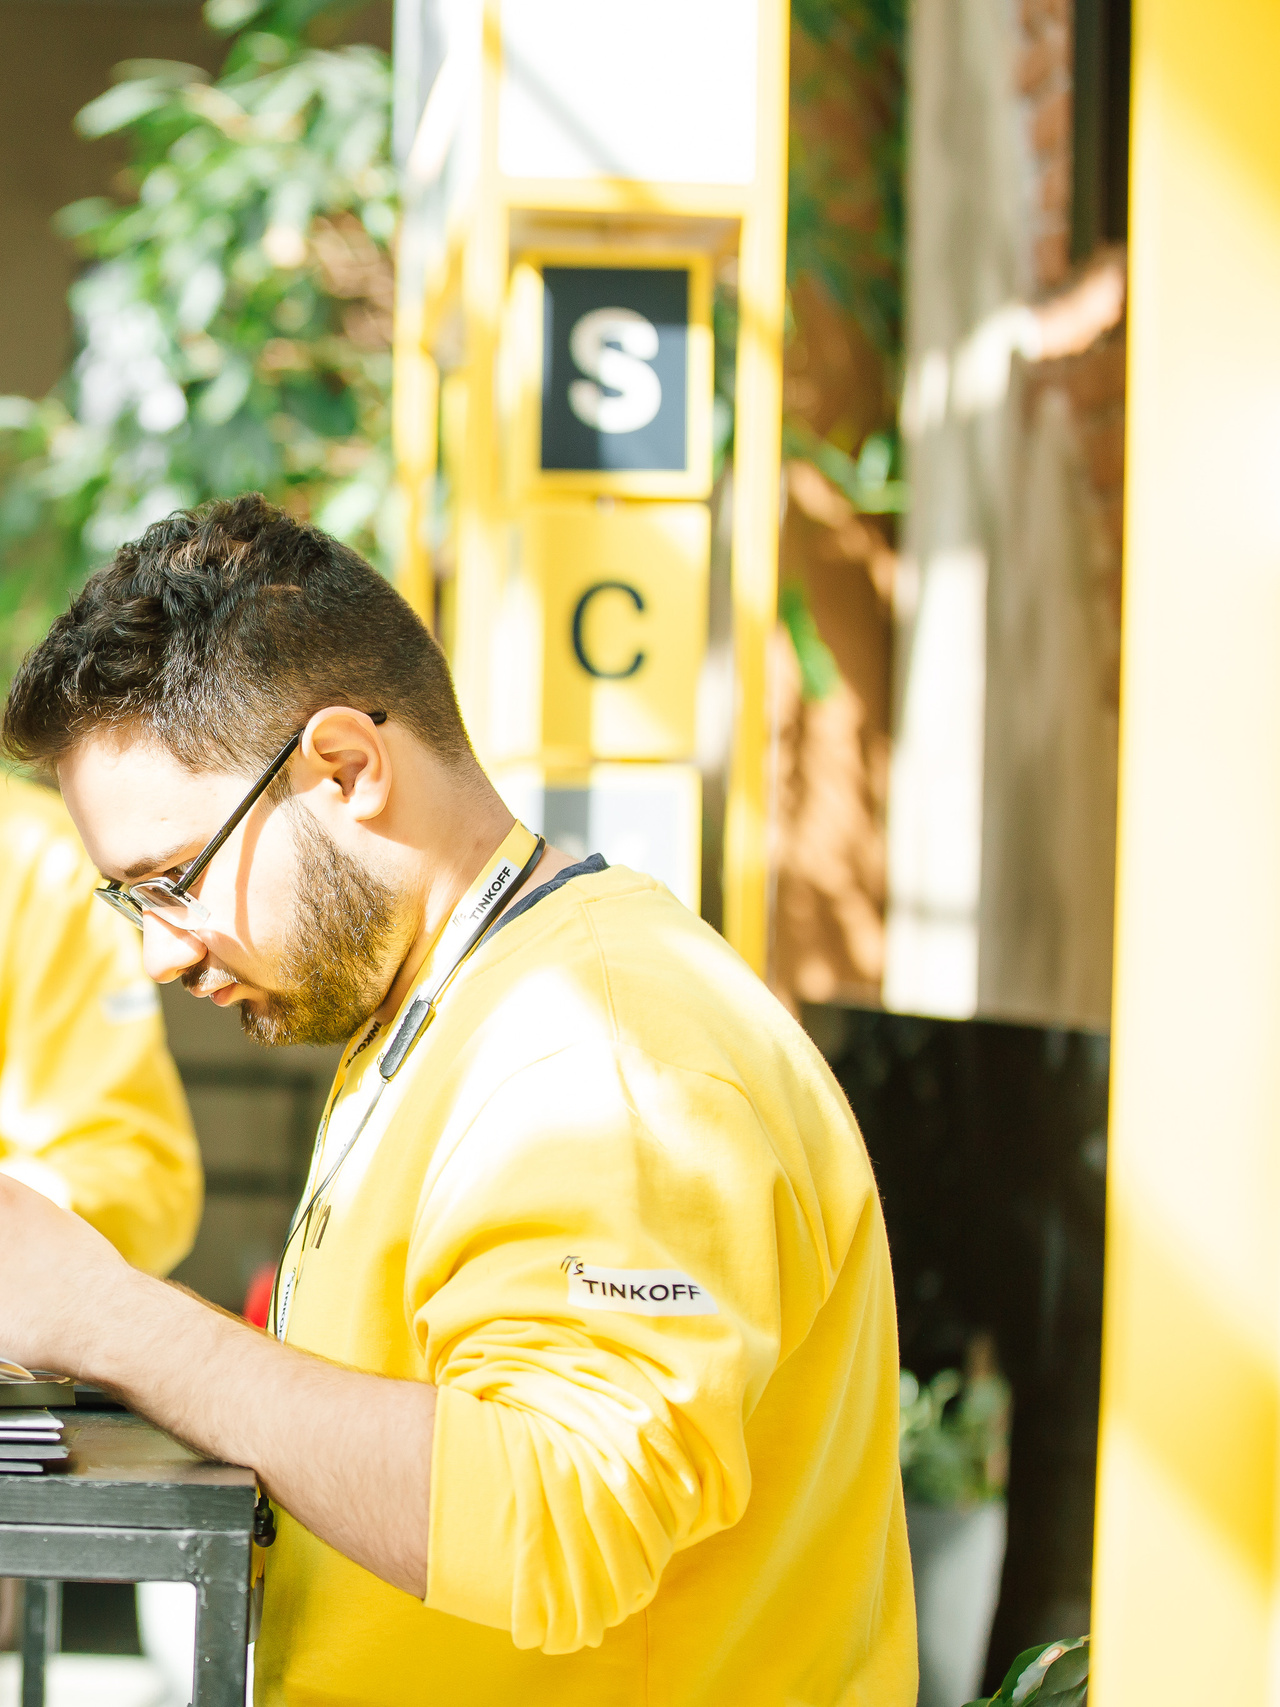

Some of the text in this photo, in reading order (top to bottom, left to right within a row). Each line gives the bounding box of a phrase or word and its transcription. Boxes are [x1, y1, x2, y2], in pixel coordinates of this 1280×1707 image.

[567, 306, 662, 434] S
[571, 579, 647, 681] C
[469, 866, 511, 920] TINKOFF
[582, 1279, 701, 1301] TINKOFF
